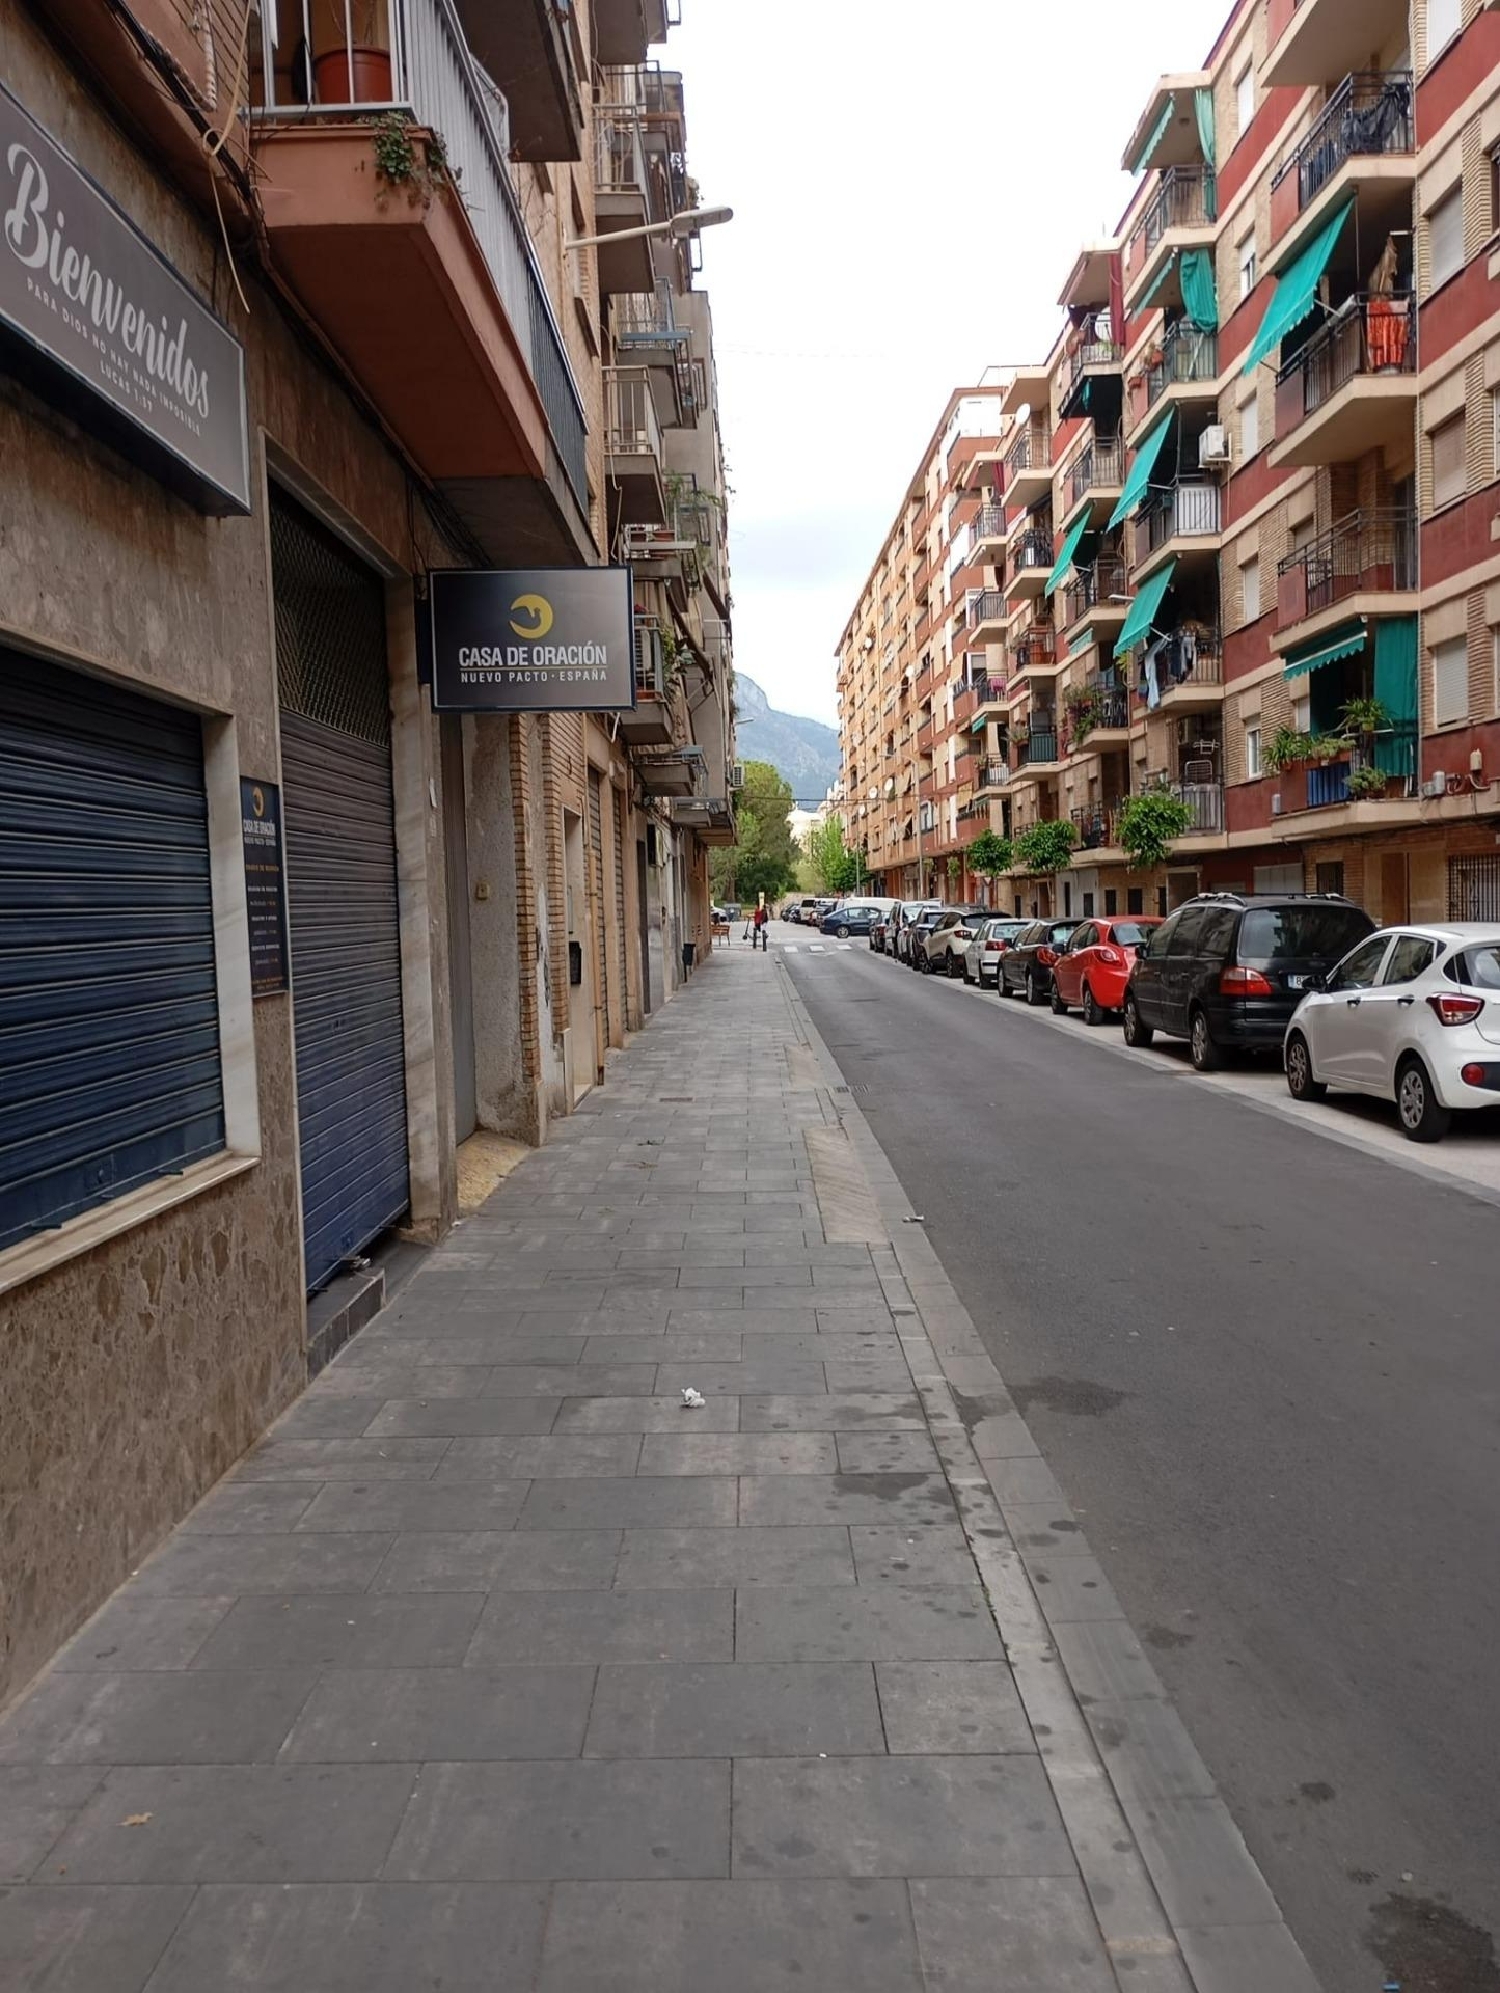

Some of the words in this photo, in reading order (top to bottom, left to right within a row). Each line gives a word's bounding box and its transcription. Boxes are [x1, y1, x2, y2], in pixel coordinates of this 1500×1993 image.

[4, 143, 209, 419] Bienvenidos
[27, 276, 58, 313] PARA
[62, 306, 88, 339] DIOS
[92, 333, 107, 355] NO
[110, 348, 129, 374] HAY
[133, 367, 157, 399] NADA
[100, 359, 131, 394] LUCAS
[459, 647, 503, 667] CASA
[506, 647, 529, 666] DE
[532, 640, 607, 666] ORACIÓN
[460, 671, 502, 683] NUEVO
[508, 671, 548, 682] PACTO
[559, 668, 607, 681] ESPAÑA
